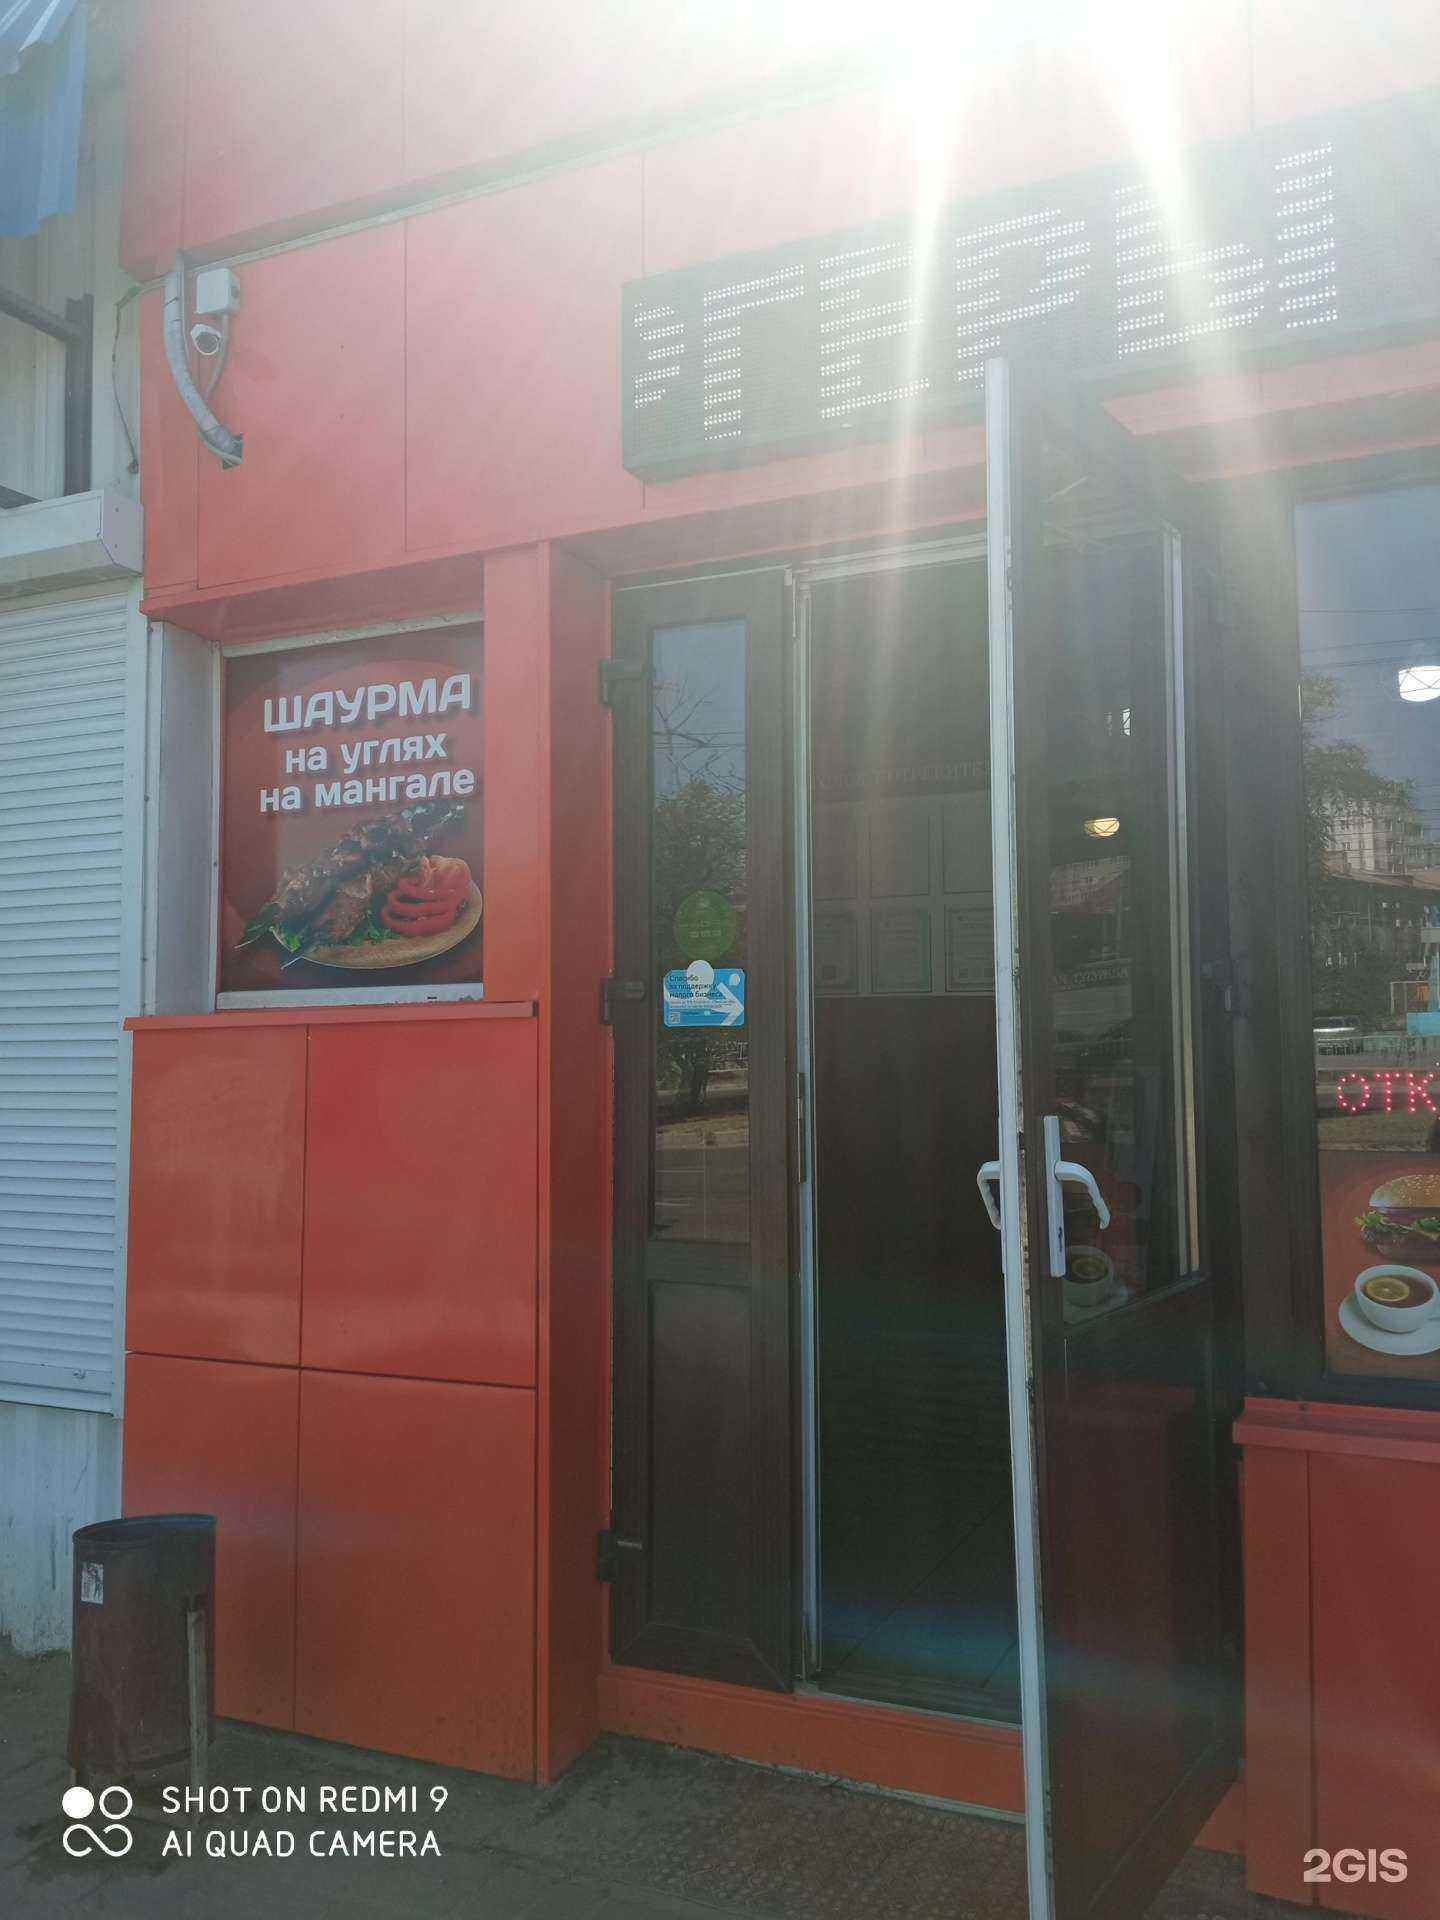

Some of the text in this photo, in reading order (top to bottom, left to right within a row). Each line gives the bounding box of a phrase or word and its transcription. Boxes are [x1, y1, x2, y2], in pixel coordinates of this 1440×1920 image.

[264, 674, 471, 733] ШАУРМА
[285, 733, 448, 774] на углях
[260, 769, 475, 812] на мангале
[1336, 1072, 1438, 1113] ОТК
